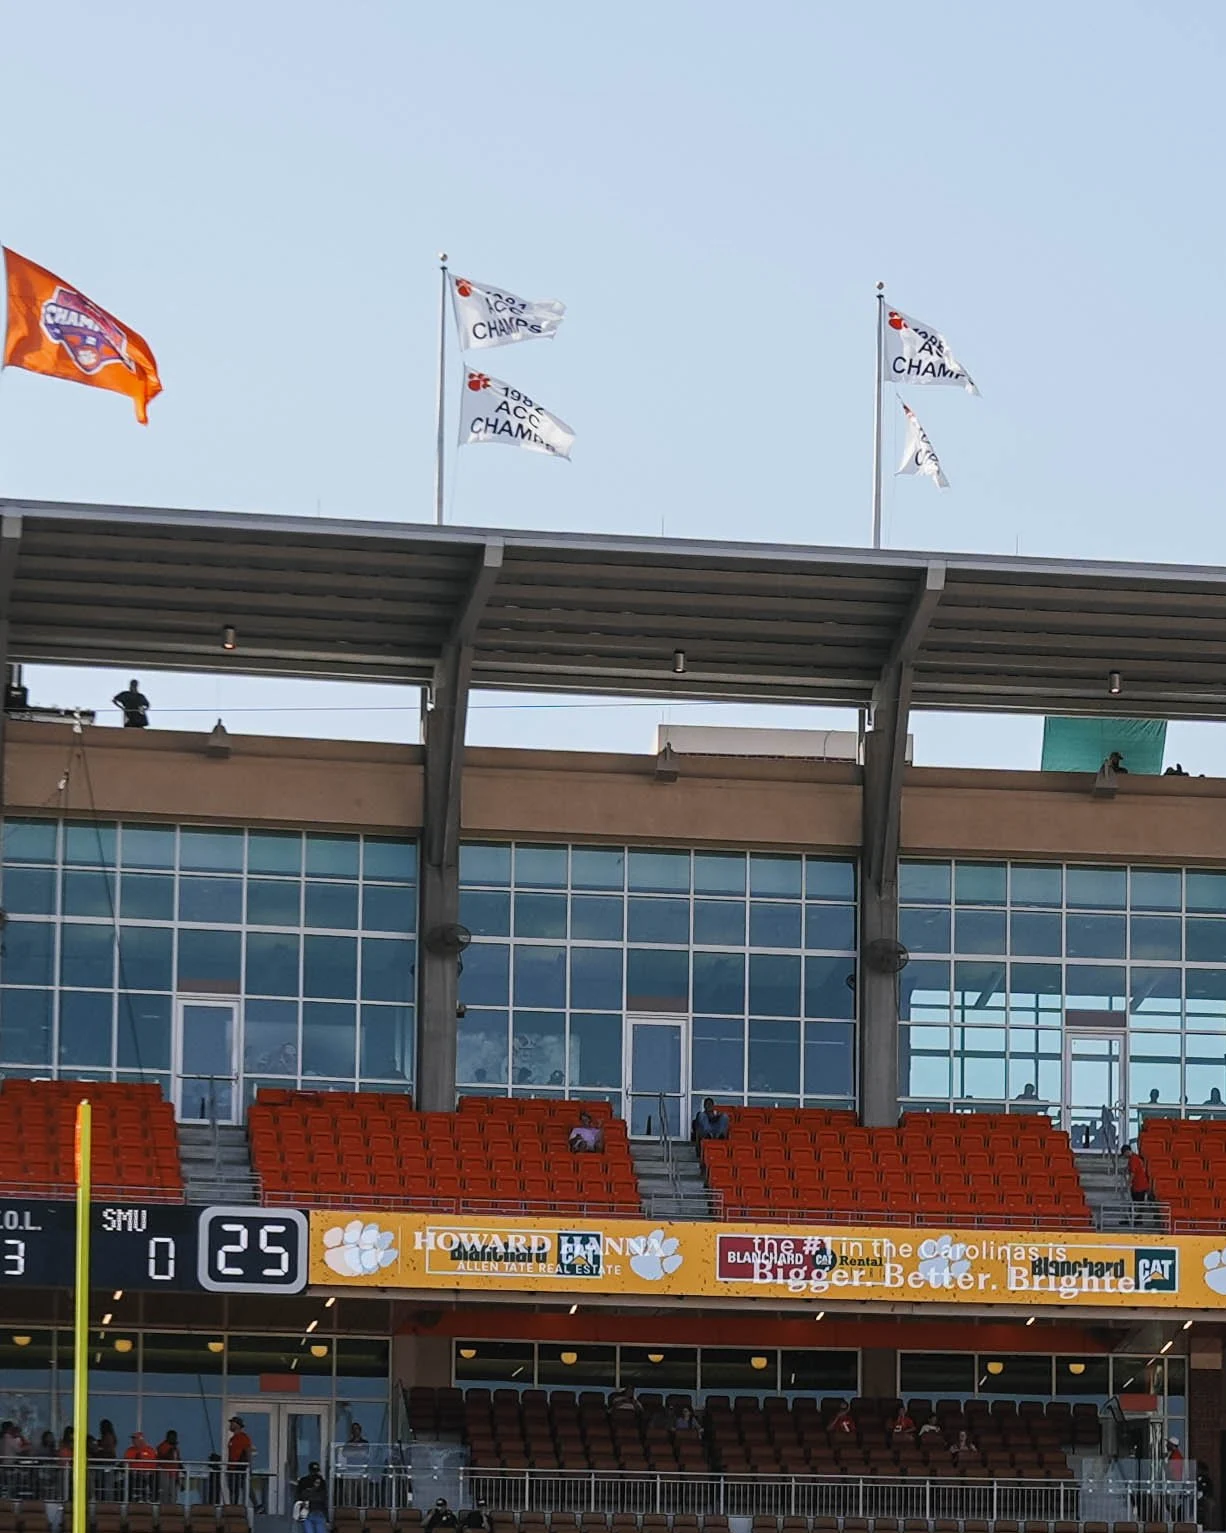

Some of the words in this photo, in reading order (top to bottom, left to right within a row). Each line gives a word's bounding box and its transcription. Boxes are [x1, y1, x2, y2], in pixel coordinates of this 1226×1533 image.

[472, 317, 542, 339] CHAMPS
[495, 401, 540, 429] ACC
[102, 1208, 147, 1232] SMU
[217, 1223, 289, 1276] 25
[414, 1231, 551, 1255] HOWARD
[559, 1236, 666, 1258] HANNA
[753, 1236, 794, 1255] the
[841, 1237, 864, 1256] in
[872, 1239, 912, 1258] the
[919, 1239, 1040, 1262] Carolinas
[1048, 1243, 1067, 1262] is
[148, 1237, 175, 1280] 0
[456, 1259, 498, 1272] ALLEN
[503, 1261, 534, 1273] TATE
[539, 1263, 571, 1275] REAL
[575, 1263, 622, 1276] ESTATE
[727, 1251, 804, 1265] BLANCHARD
[839, 1256, 884, 1267] Rental
[1138, 1258, 1173, 1281] CAT
[752, 1261, 873, 1293] Bigger.
[884, 1262, 998, 1291] Better.
[1009, 1266, 1158, 1299] Brighter.
